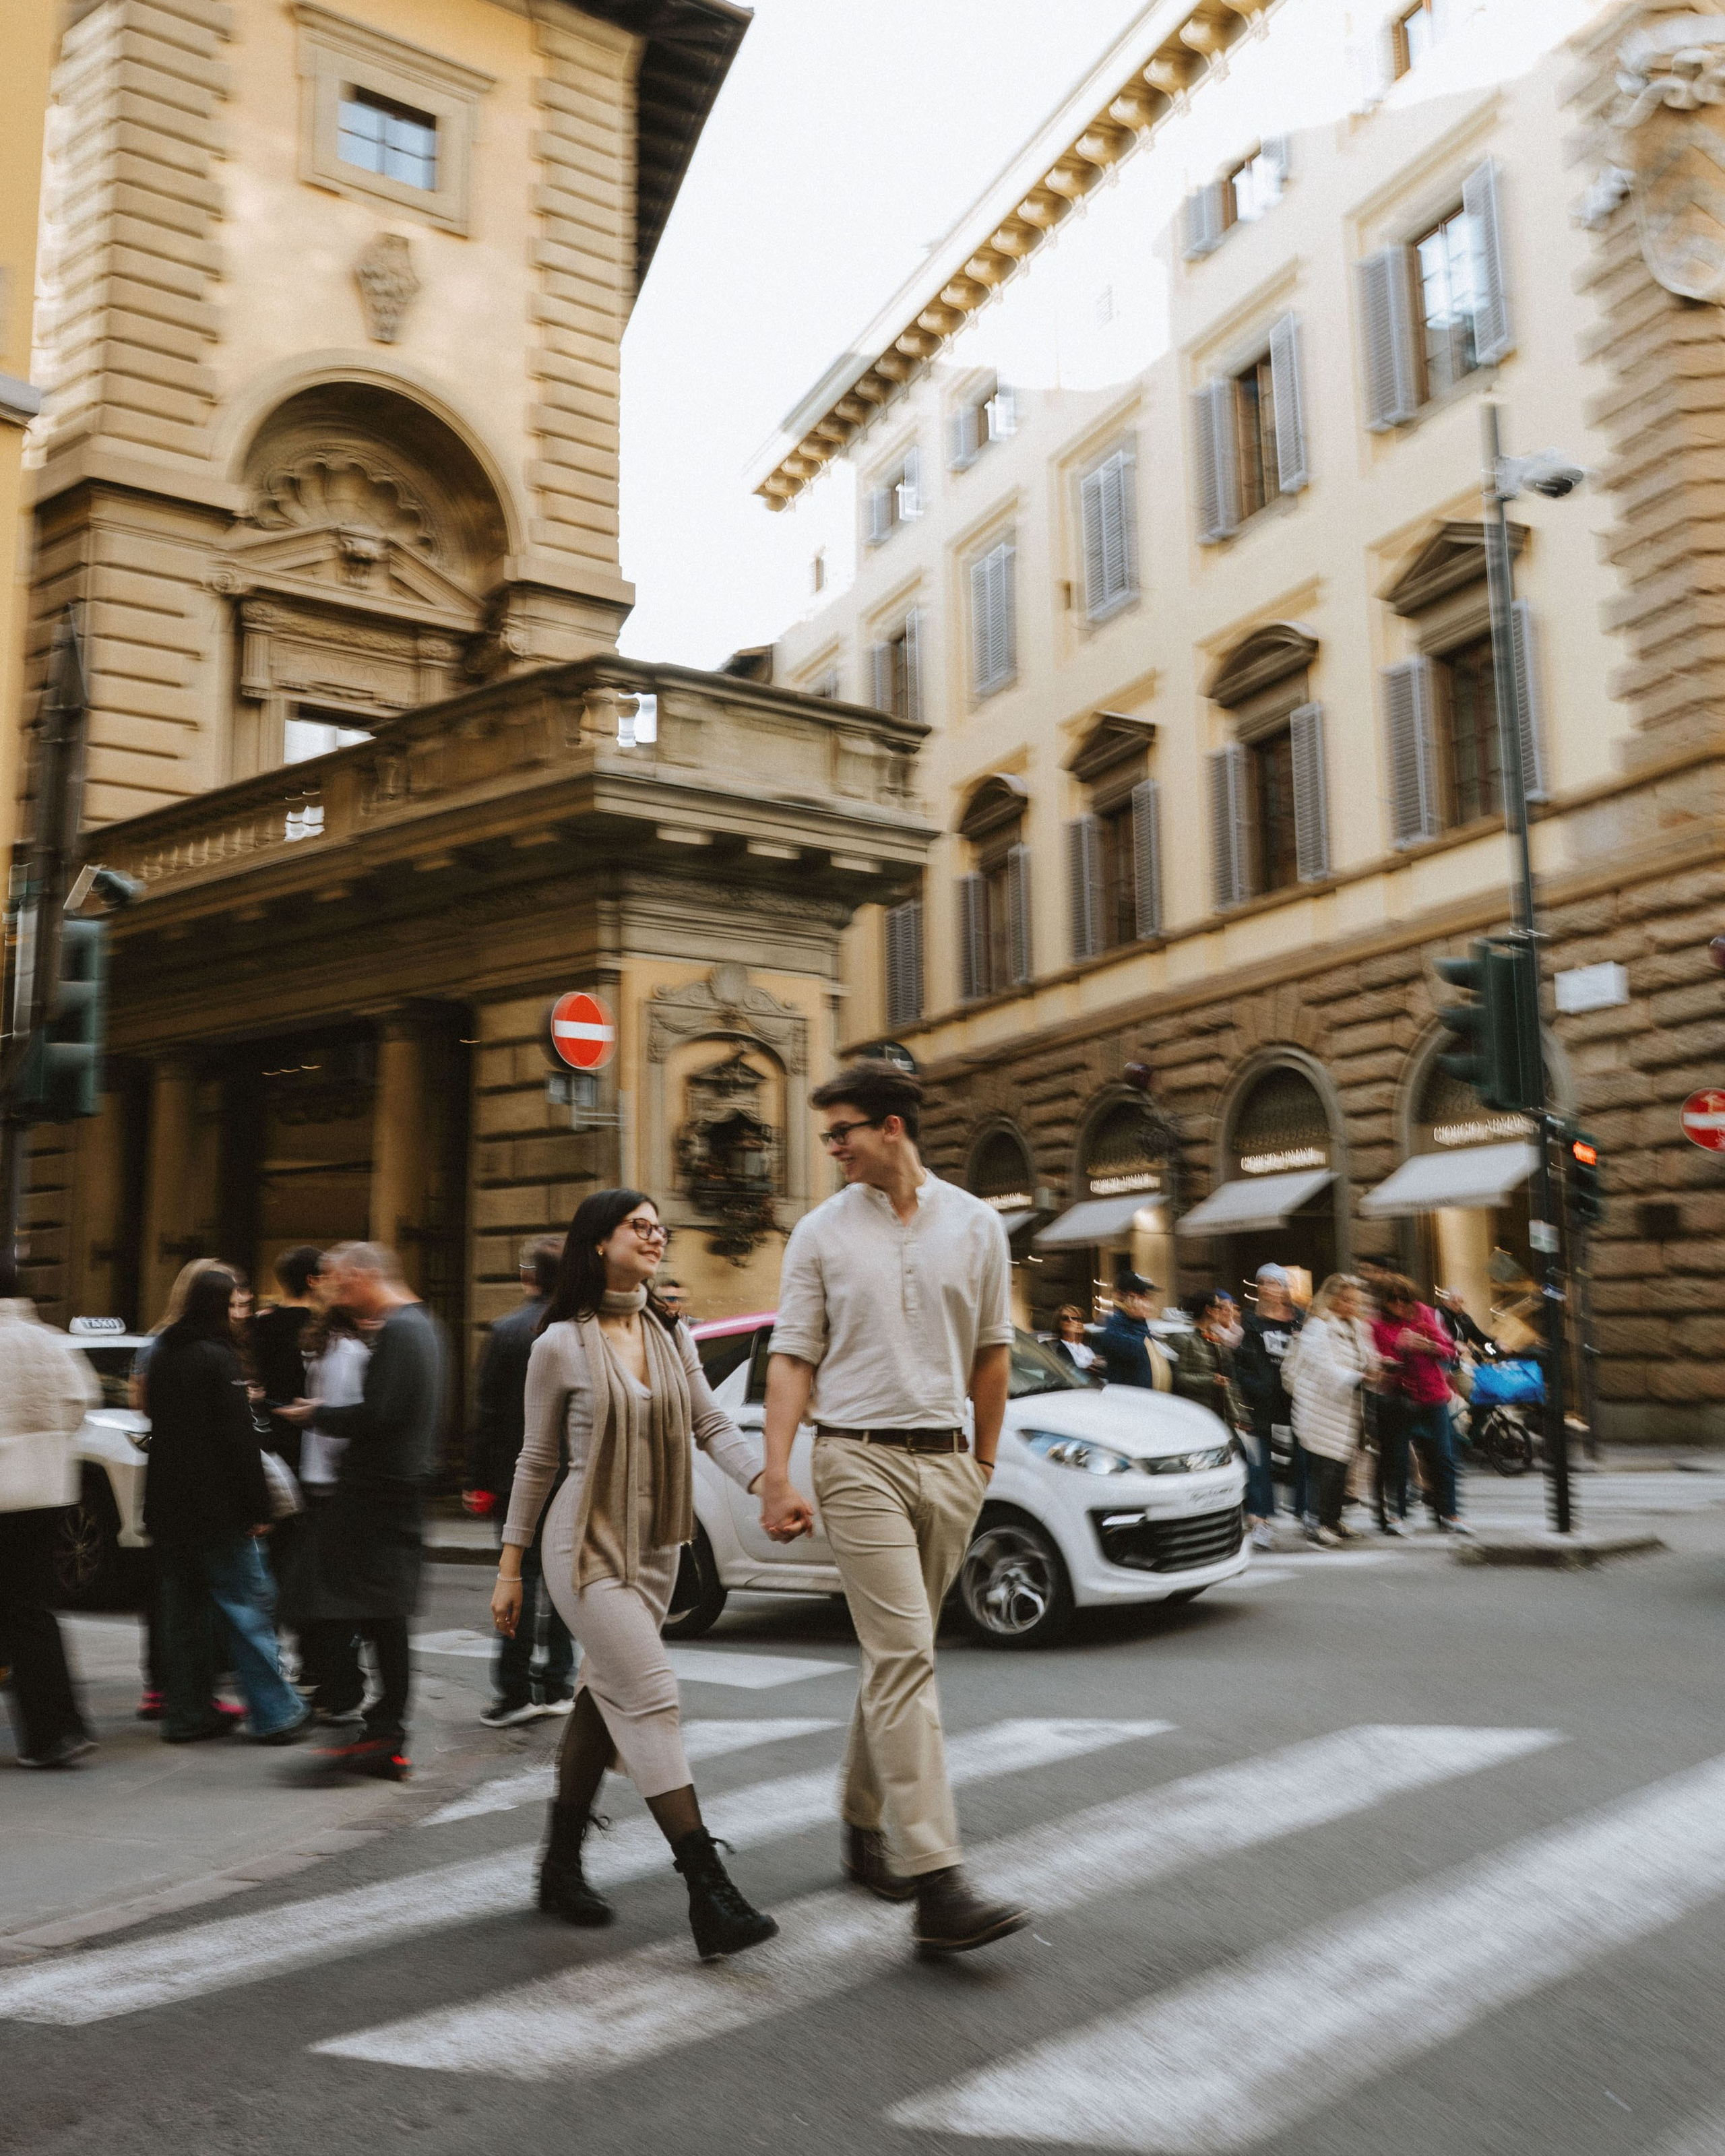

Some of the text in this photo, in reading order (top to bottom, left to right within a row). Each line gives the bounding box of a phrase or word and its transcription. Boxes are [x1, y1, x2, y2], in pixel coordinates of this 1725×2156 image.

[1433, 1113, 1540, 1147] GIORGIO ARMAN
[81, 1318, 119, 1329] TAXI
